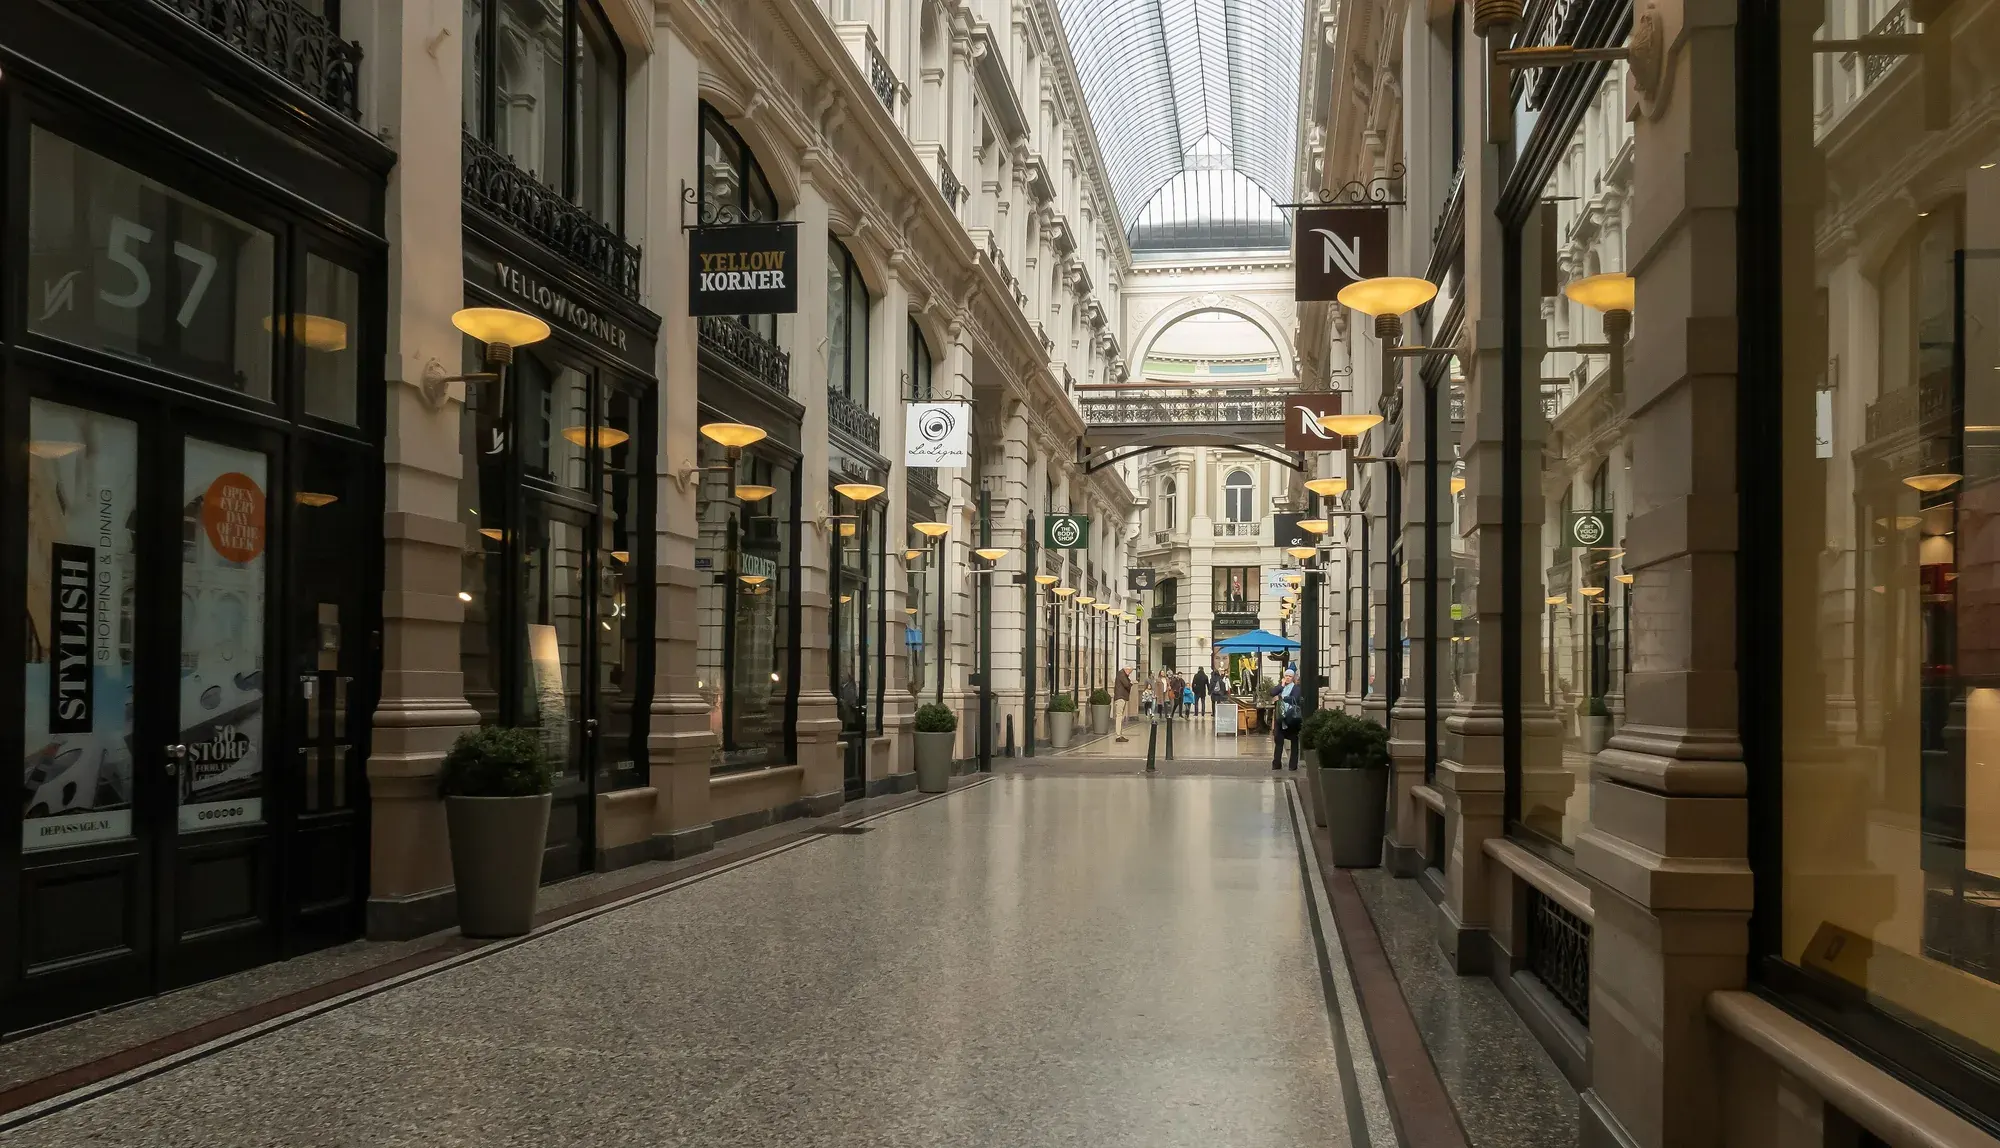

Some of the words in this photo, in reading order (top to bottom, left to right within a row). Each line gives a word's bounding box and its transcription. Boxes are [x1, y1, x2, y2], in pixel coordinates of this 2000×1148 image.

[700, 251, 786, 272] YELLOW
[100, 215, 218, 329] 57
[700, 271, 786, 292] KORNER
[496, 262, 627, 351] YELLOWKORNER
[223, 486, 253, 502] OPEN
[220, 498, 255, 514] EVERY
[99, 488, 113, 548] DINING
[227, 511, 248, 525] DAY
[217, 522, 232, 536] OF
[235, 525, 259, 540] THE
[220, 535, 254, 551] WEEK
[100, 553, 112, 565] &
[98, 571, 112, 661] SHOPPING
[58, 559, 89, 721] STYLISH
[214, 724, 236, 742] 50
[40, 820, 111, 836] DEPASSAGE.NL
